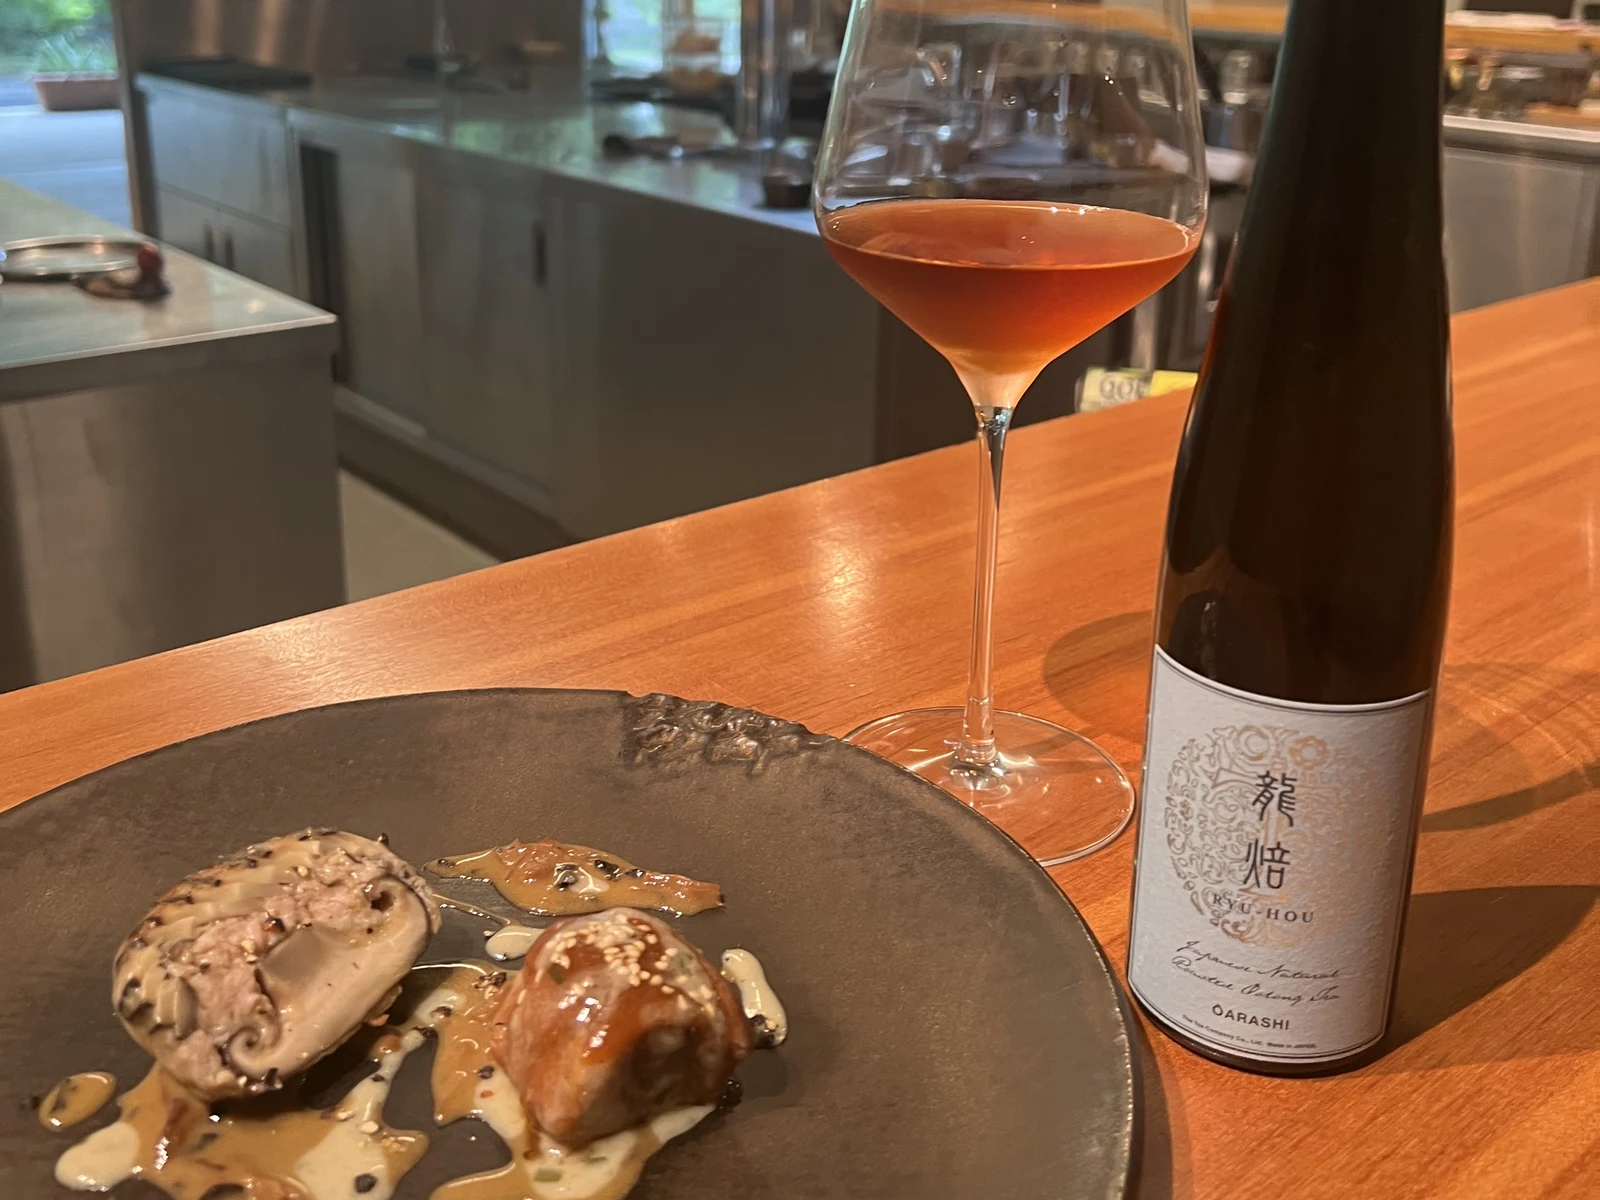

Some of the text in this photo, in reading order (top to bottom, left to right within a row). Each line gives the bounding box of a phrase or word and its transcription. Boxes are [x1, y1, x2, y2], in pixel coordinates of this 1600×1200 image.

[1243, 769, 1298, 889] 龍焙
[1212, 893, 1315, 923] RYU-HOU
[1172, 956, 1234, 990] Roasted
[1241, 983, 1304, 1007] Oolong
[1176, 940, 1343, 980] Japanese Natural
